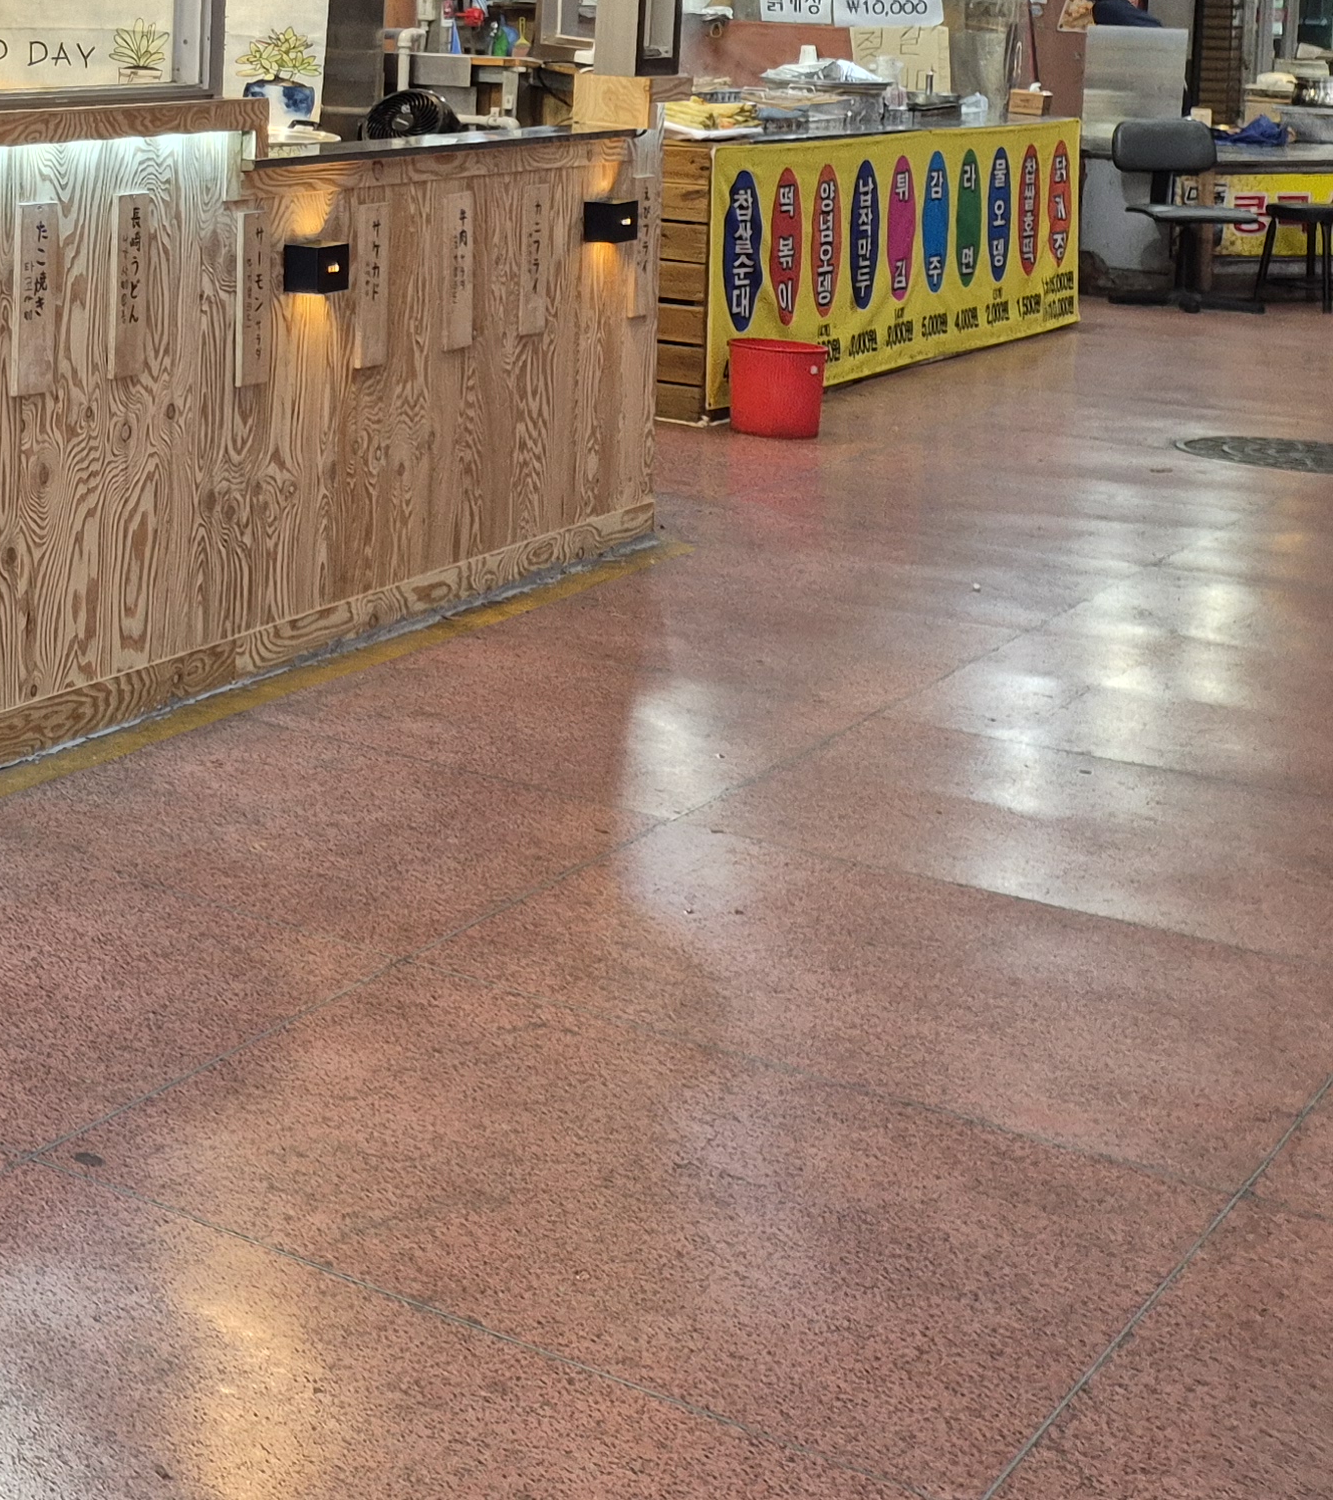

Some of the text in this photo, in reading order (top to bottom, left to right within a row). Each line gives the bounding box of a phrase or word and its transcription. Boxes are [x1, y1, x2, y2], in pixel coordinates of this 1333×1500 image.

[27, 40, 96, 69] DAY
[846, 0, 928, 18] ₩10,000
[731, 188, 755, 319] 찹쌀순대
[777, 184, 795, 313] 떡볶이
[817, 180, 836, 305] 양념오뎅
[855, 176, 874, 298] 납작만두
[893, 171, 909, 290] 튀김
[928, 170, 944, 285] 감주
[961, 163, 976, 275] 라면
[992, 158, 1008, 267] 물오뎅
[1022, 157, 1037, 266] 찹쌀호떡
[1052, 155, 1067, 260] 닭개장
[33, 220, 49, 318] たこ焼き
[129, 206, 142, 324] 長崎うどん
[954, 306, 979, 334] 4,000원
[921, 312, 948, 341] 5,000원
